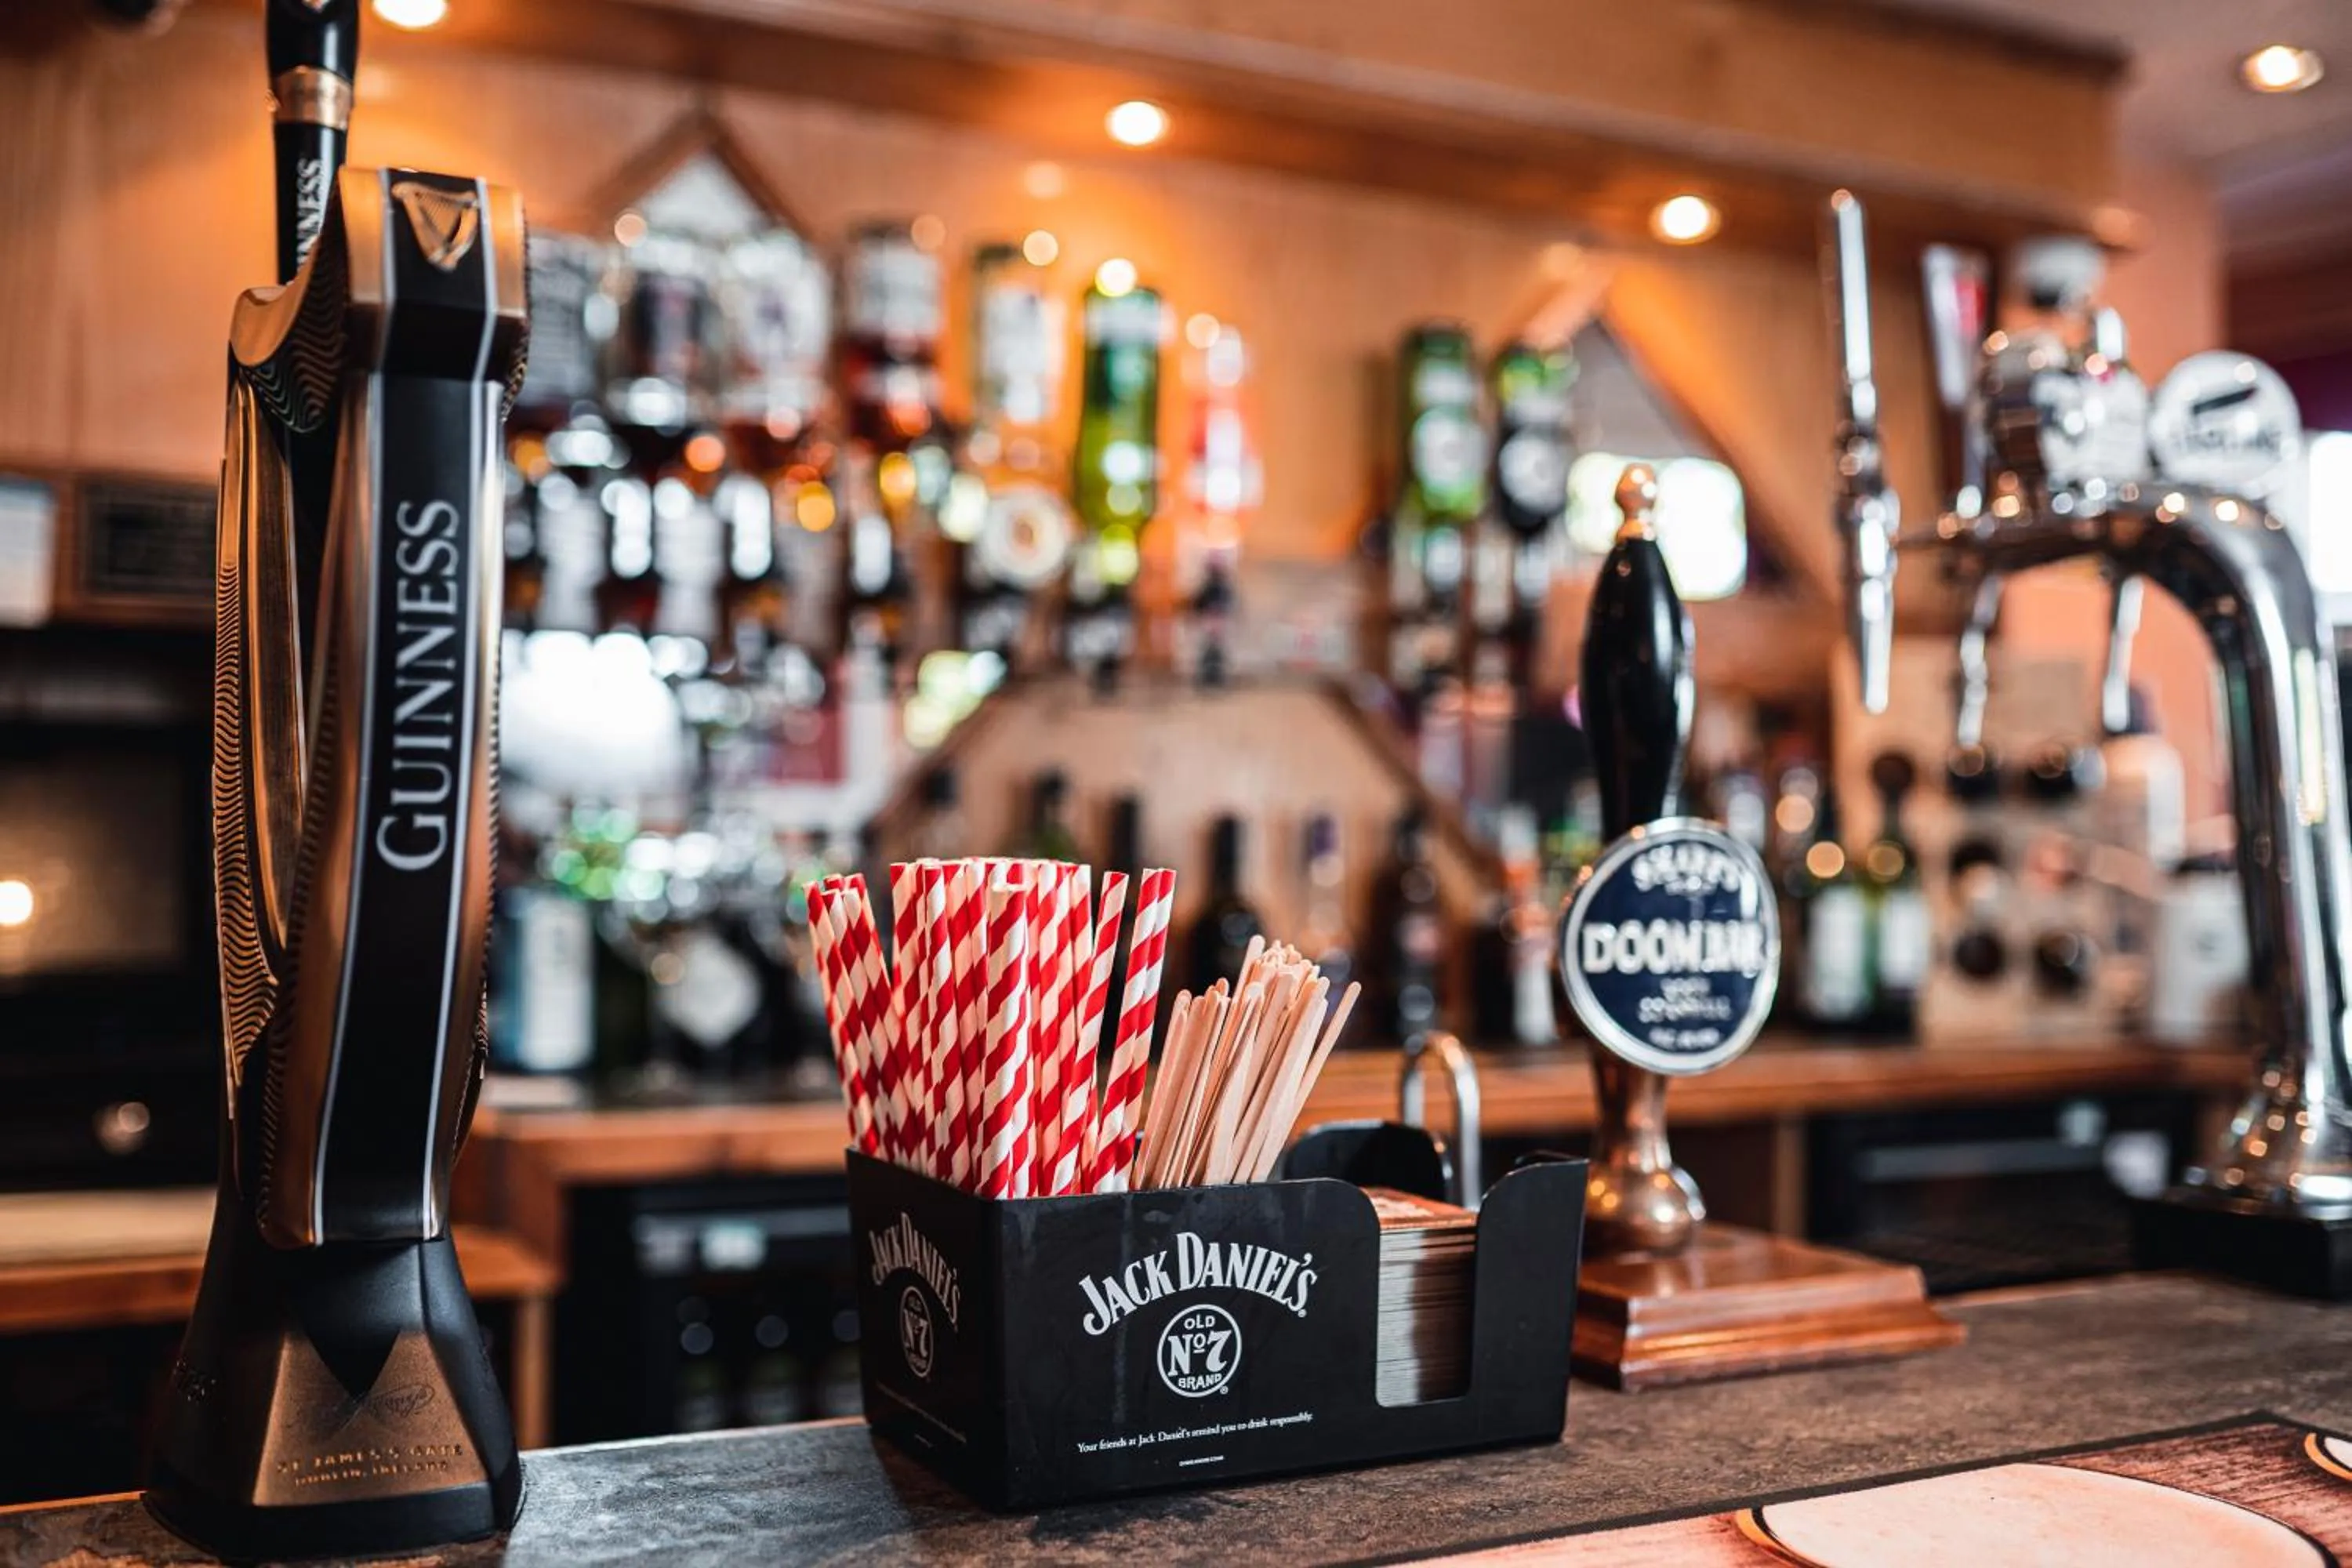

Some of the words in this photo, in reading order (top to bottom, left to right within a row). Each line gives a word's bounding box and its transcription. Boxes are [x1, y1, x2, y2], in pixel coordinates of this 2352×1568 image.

[376, 499, 460, 871] GUINNESS
[869, 1223, 902, 1287] JACK
[1078, 1250, 1177, 1336] JACK
[1176, 1231, 1318, 1312] DANIEL'S
[1183, 1313, 1216, 1330] OLD
[1178, 1373, 1223, 1391] BRAND
[1077, 1442, 1098, 1453] Your
[1099, 1437, 1127, 1450] friends
[1138, 1432, 1156, 1447] Jack
[1158, 1426, 1191, 1443] Daniel's
[1191, 1423, 1220, 1437] remind
[1221, 1423, 1236, 1436] you
[1237, 1422, 1247, 1431] to
[1248, 1417, 1269, 1429] drink
